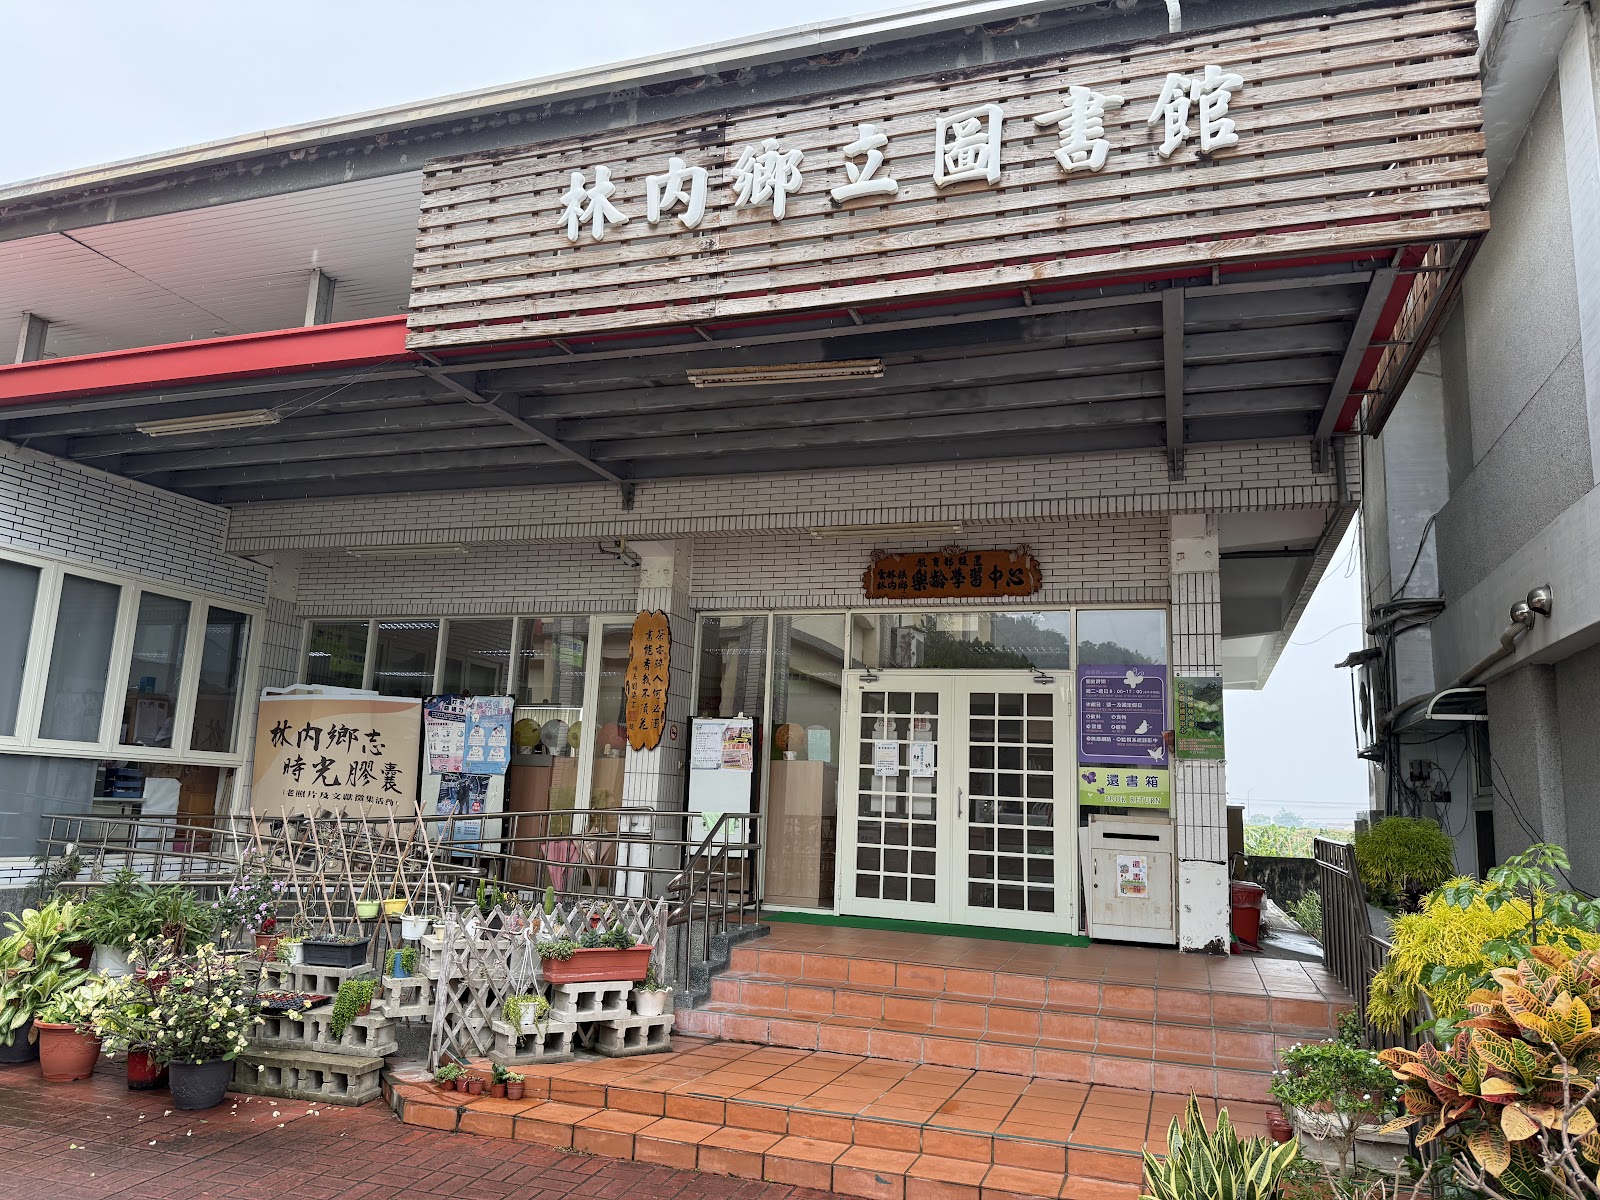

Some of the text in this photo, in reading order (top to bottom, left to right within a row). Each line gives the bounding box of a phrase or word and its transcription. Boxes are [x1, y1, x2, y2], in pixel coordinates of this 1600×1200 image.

[556, 64, 1244, 244] 林內鄉立圖書館
[915, 554, 984, 569] 教育部設置
[876, 580, 908, 591] 林內鄉
[911, 564, 1025, 592] 樂齡學習中心
[270, 720, 386, 757] 林內鄉志
[282, 754, 403, 795] 時光膠囊
[1106, 774, 1159, 788] 還書箱
[1104, 795, 1162, 805] BOOK RETURN
